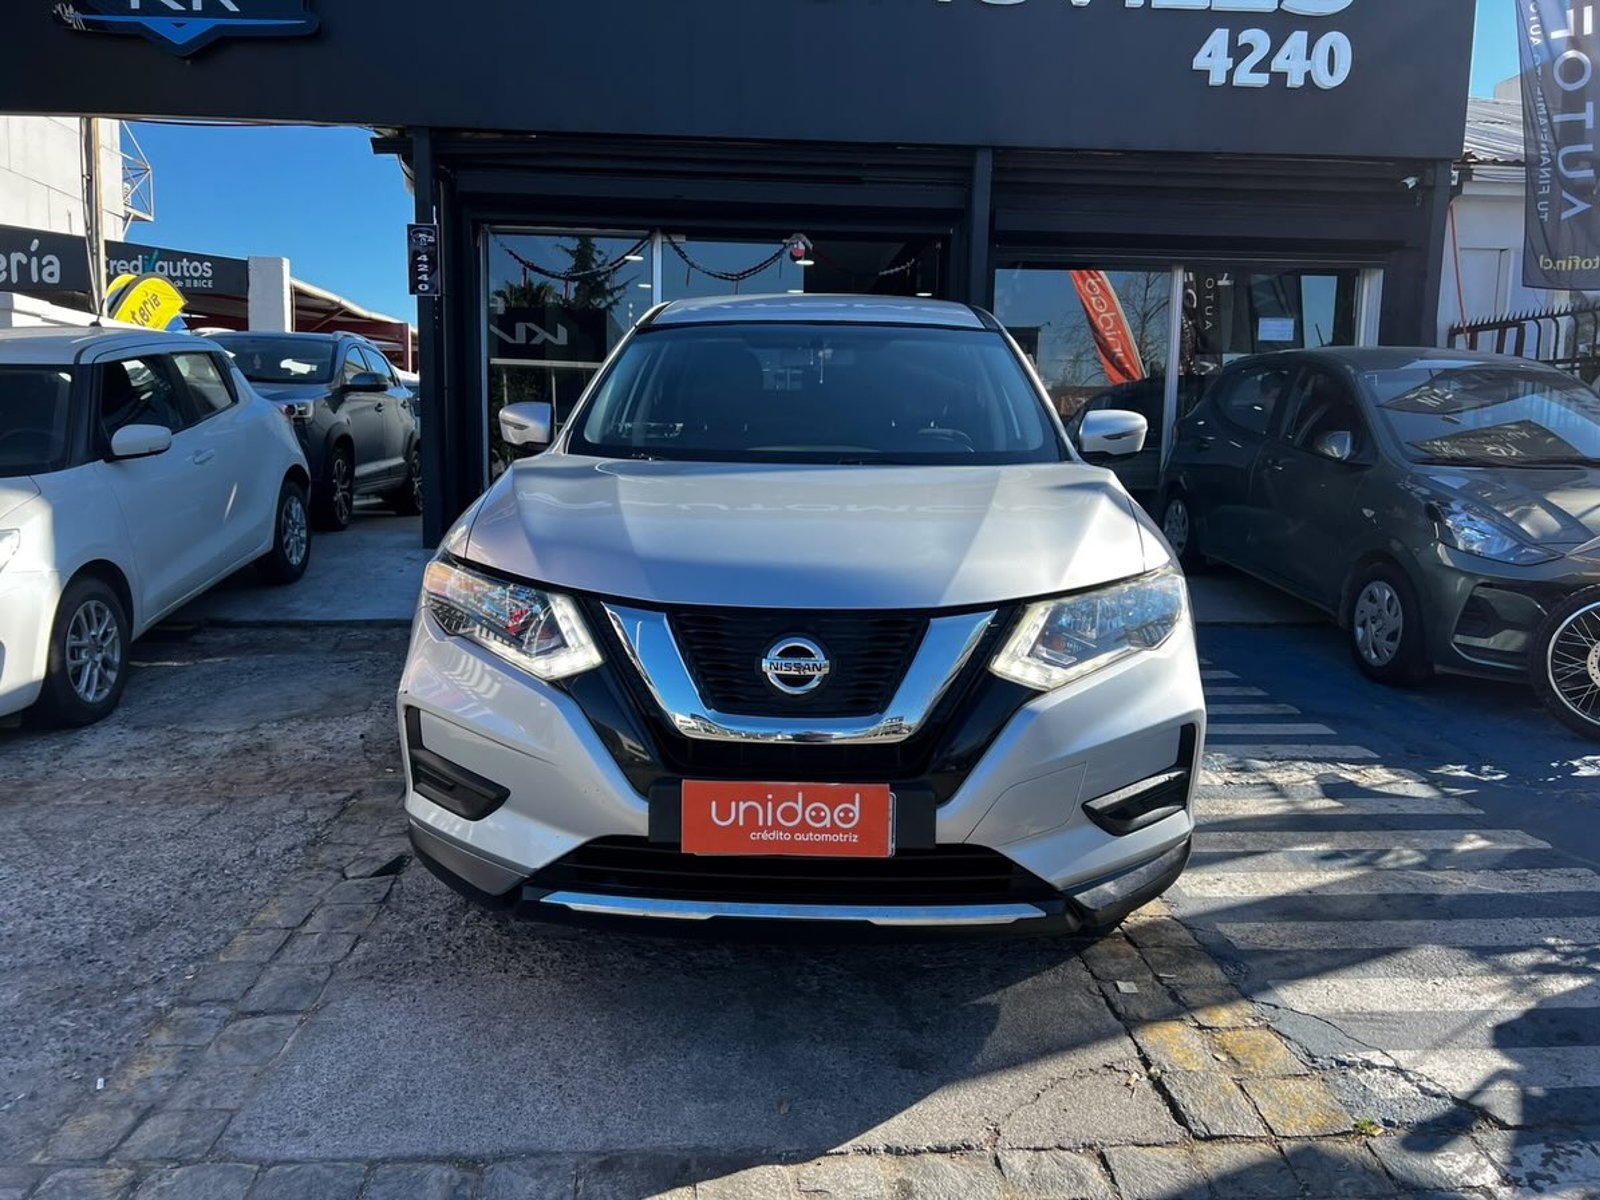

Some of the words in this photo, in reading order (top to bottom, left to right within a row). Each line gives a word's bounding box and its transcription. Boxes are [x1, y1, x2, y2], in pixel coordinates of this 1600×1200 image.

[1192, 28, 1353, 89] 4240
[416, 254, 429, 291] 4240
[769, 661, 823, 673] NISSAN
[710, 792, 860, 829] unidad
[749, 829, 791, 841] crédito
[794, 831, 859, 843] automotriz
